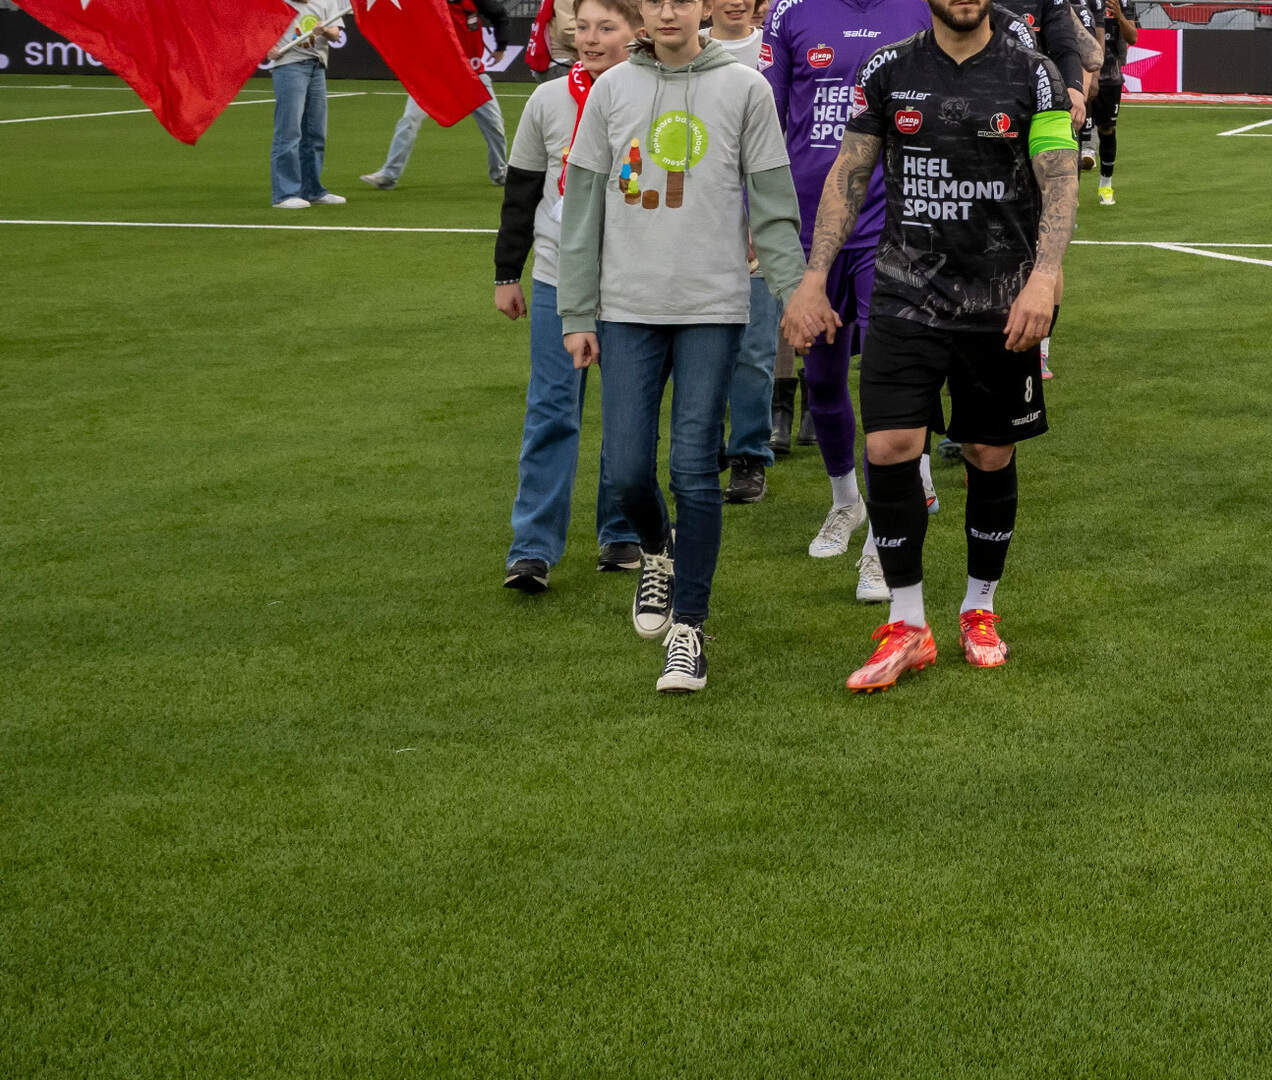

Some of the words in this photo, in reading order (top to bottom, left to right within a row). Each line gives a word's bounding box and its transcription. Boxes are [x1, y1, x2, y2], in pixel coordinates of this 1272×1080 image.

[843, 28, 882, 38] saller
[891, 89, 932, 101] saller
[902, 155, 953, 178] HEEL
[902, 176, 1005, 202] HELMOND
[902, 199, 973, 221] SPORT
[1024, 375, 1033, 403] 8
